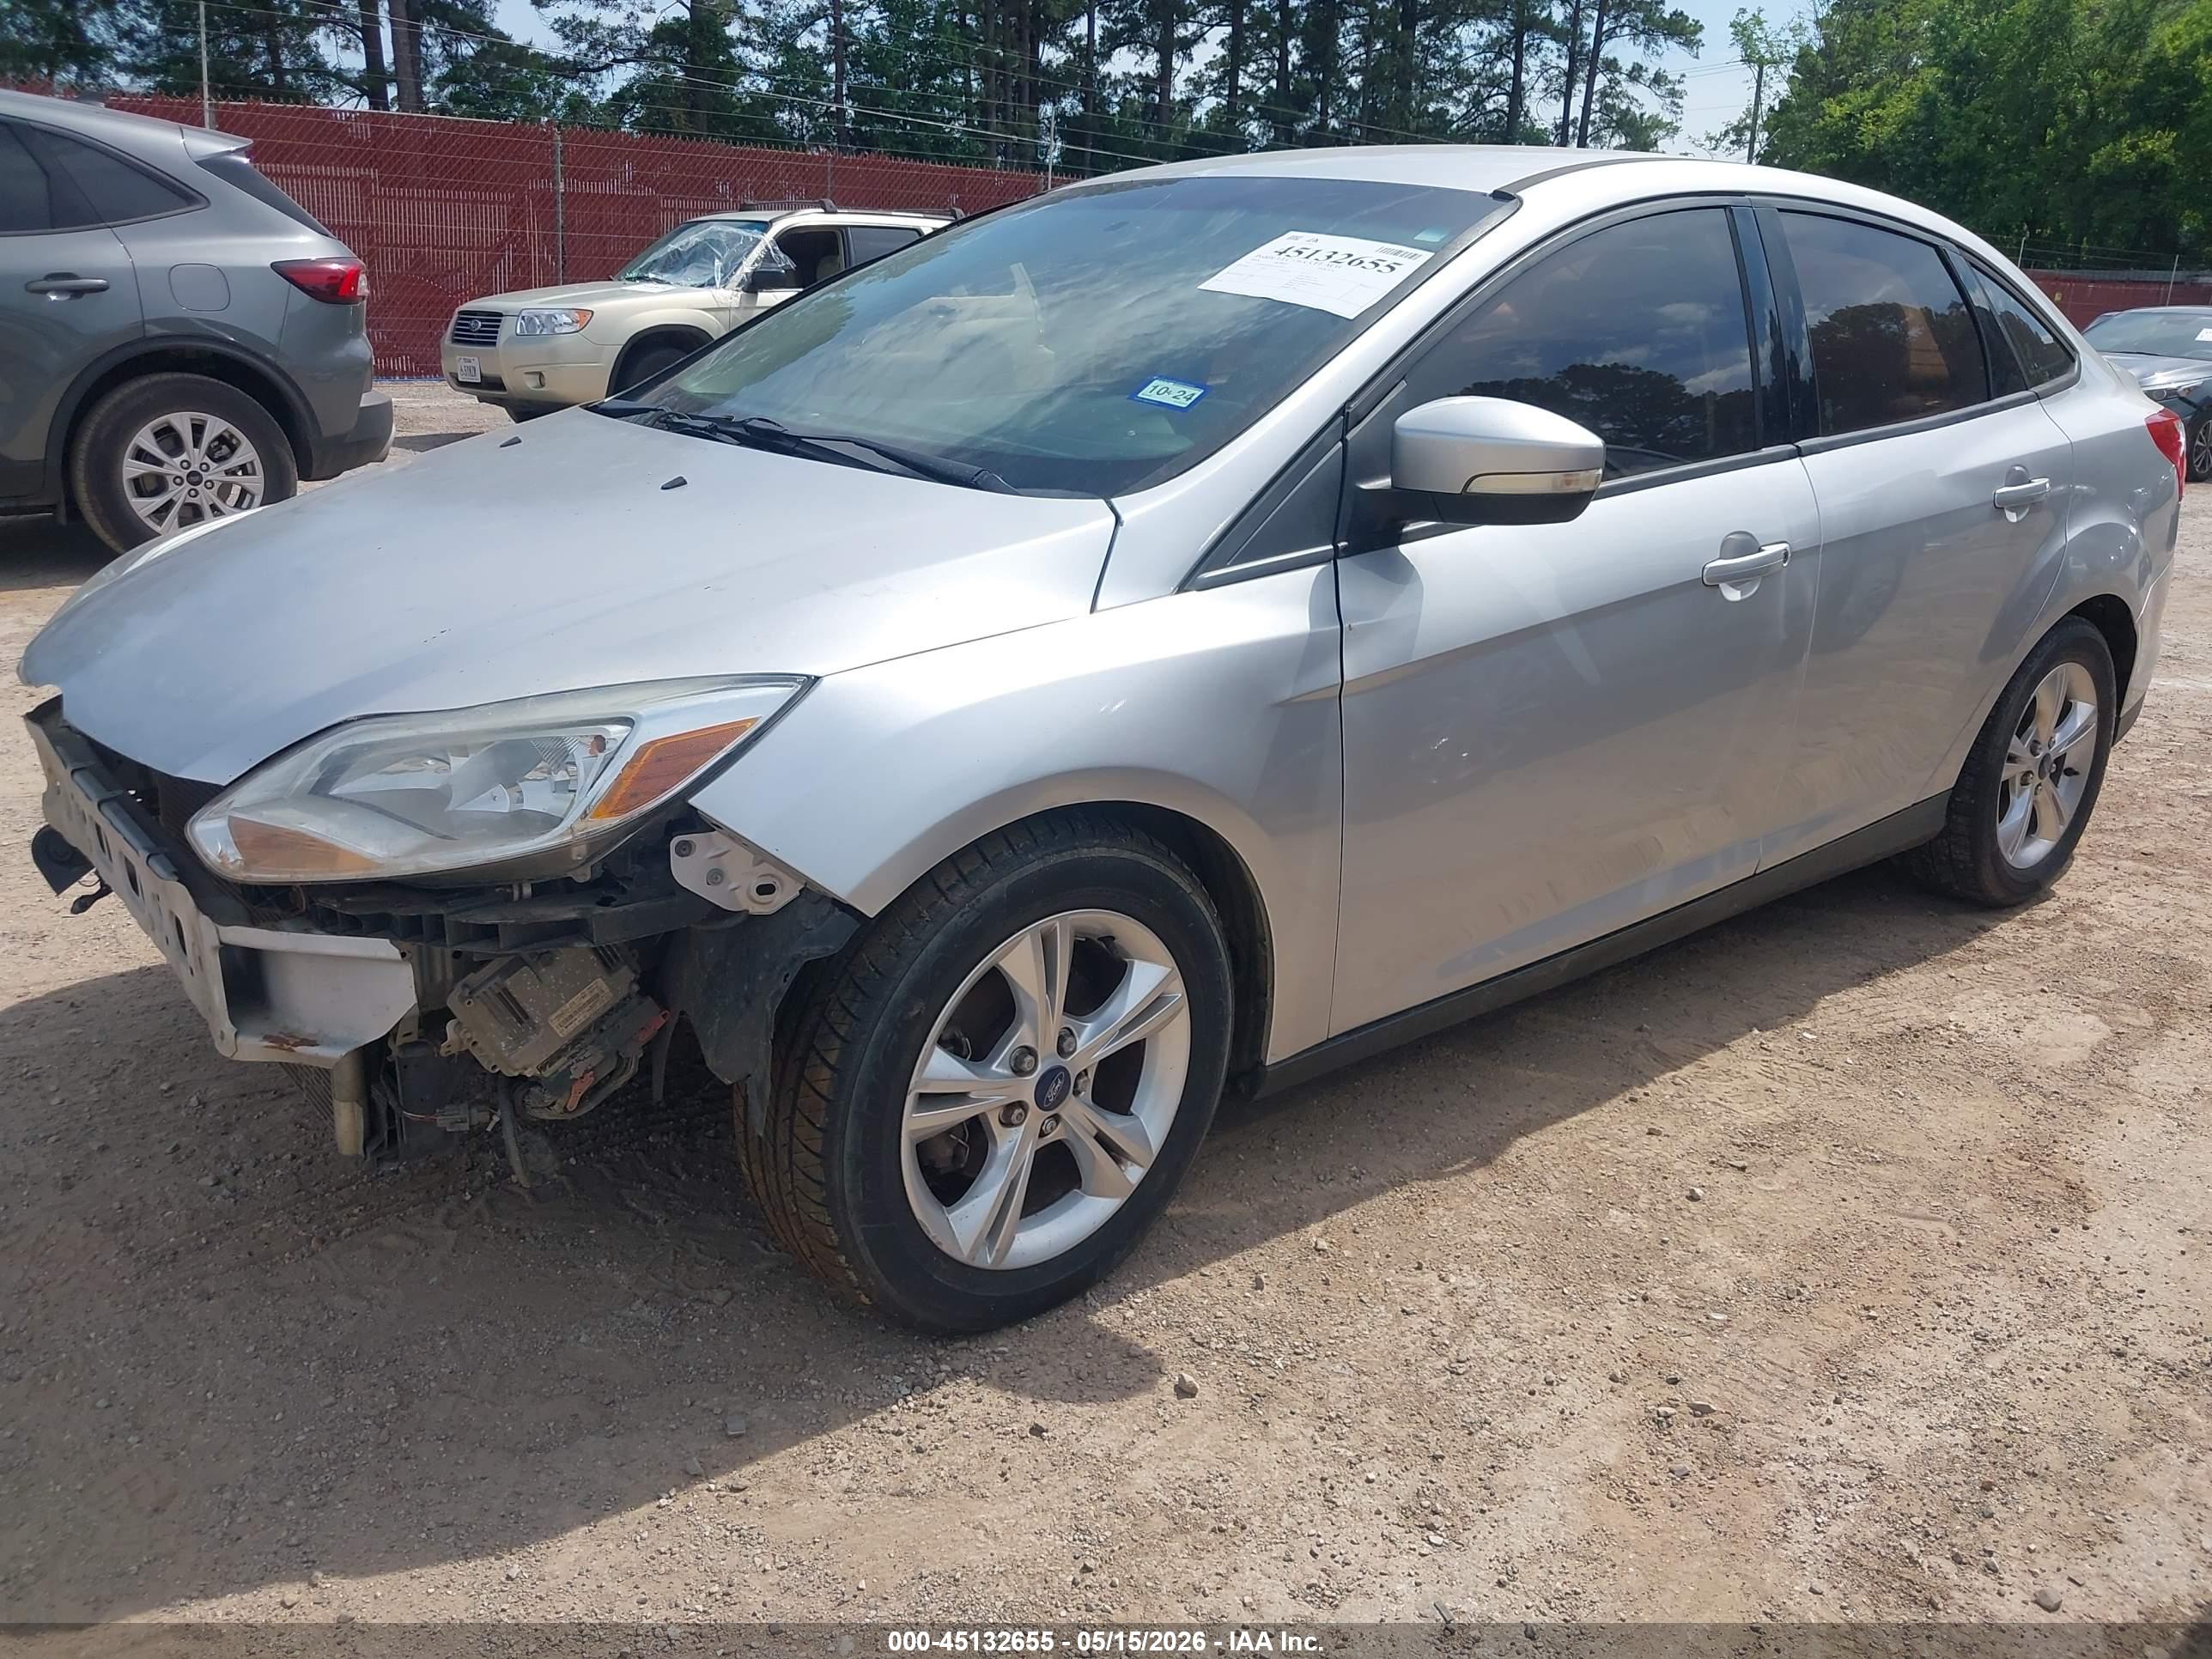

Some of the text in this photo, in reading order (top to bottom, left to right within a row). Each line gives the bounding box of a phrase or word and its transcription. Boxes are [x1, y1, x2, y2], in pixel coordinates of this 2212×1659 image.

[1274, 246, 1404, 274] 45132655
[1148, 384, 1196, 402] 10 24
